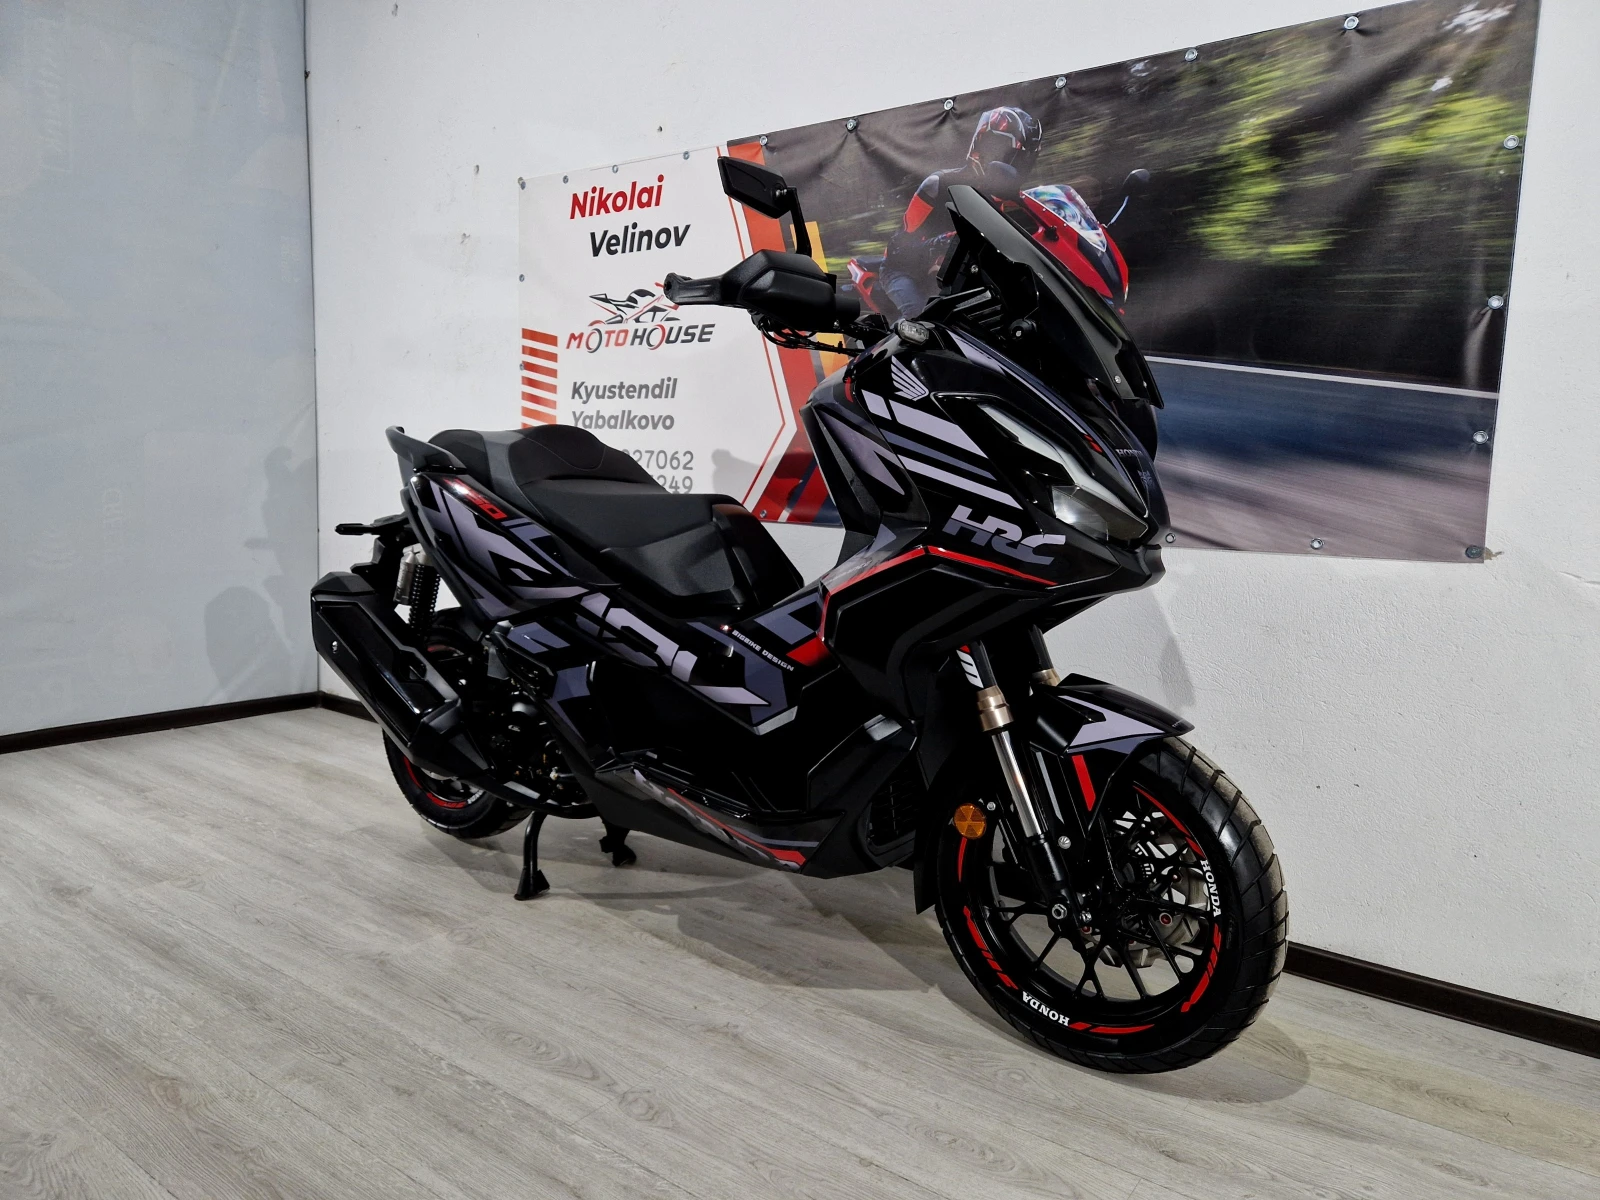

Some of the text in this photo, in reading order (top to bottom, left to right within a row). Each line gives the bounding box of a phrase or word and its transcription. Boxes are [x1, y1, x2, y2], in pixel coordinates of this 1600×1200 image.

[570, 174, 664, 220] Nikolai
[590, 222, 691, 257] Velinov
[571, 376, 677, 404] Kyustendil
[572, 410, 675, 430] Yabalkovo
[651, 474, 694, 494] 249
[942, 504, 1066, 565] HRC
[731, 629, 795, 672] BIGBIKE DESIGN
[1200, 859, 1222, 918] HONDA
[1022, 991, 1070, 1027] HONDA
